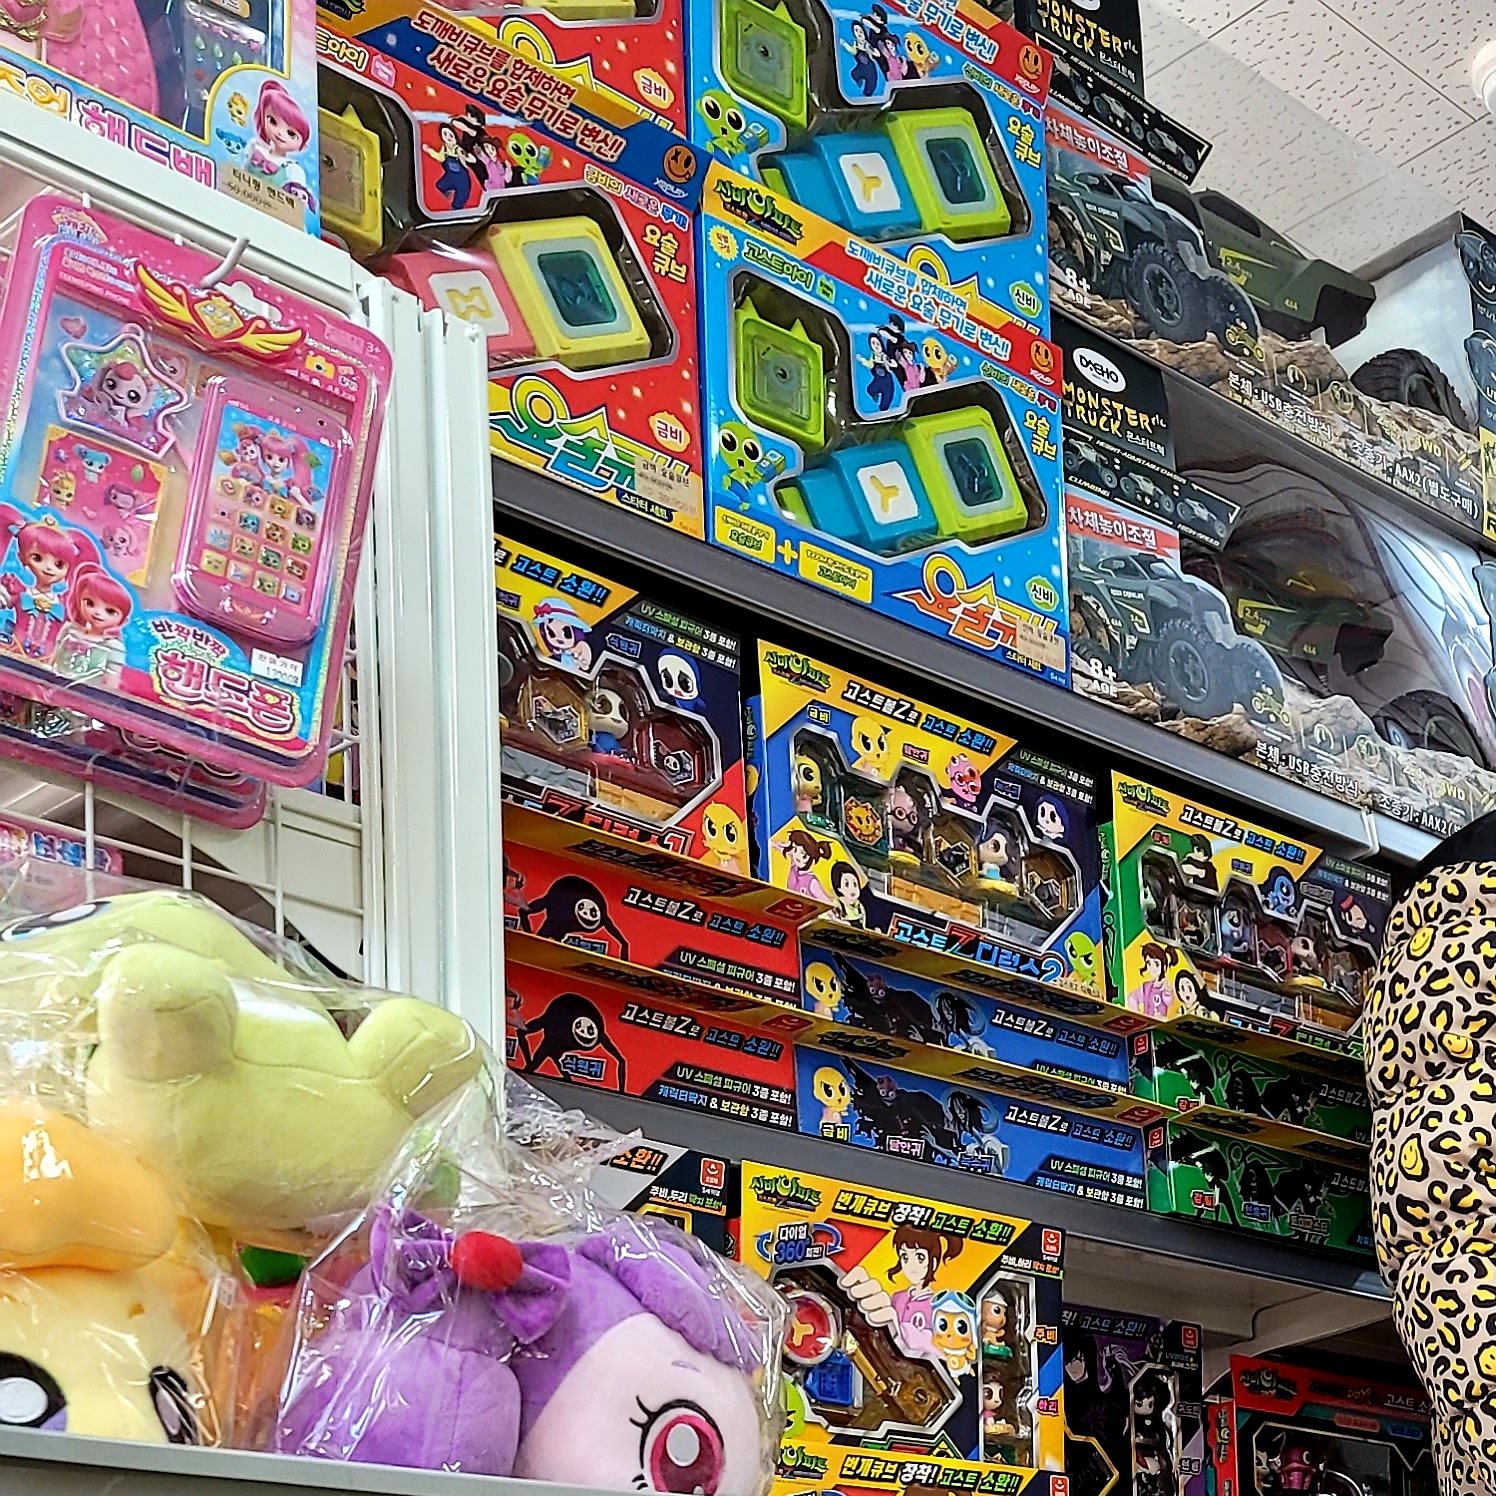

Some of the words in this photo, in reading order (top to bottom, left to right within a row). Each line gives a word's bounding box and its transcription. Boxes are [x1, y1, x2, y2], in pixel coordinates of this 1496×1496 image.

[1041, 9, 1095, 56] TRUCK
[412, 9, 512, 71] 도깨비큐브를
[511, 59, 577, 103] 합체하면
[428, 48, 489, 91] 새로운
[487, 77, 527, 112] 요술
[522, 94, 581, 141] 무기로
[576, 120, 626, 163] 변신!
[638, 78, 669, 102] 금비
[1014, 141, 1042, 170] 큐브
[642, 224, 679, 257] 요술
[652, 252, 688, 283] 큐브
[743, 241, 813, 288] 고스트아이
[865, 270, 908, 303] 새로운
[909, 293, 937, 321] 요술
[936, 307, 978, 343] 무기로
[978, 329, 1011, 359] 변신!
[1014, 288, 1037, 310] 신비
[1063, 380, 1153, 436] MONSTER
[1066, 400, 1123, 438] TRUCK
[656, 419, 683, 445] 금비
[1068, 505, 1158, 548] 차체높이조절
[1031, 583, 1055, 604] 신비
[152, 619, 227, 657] 반짝반짝
[1089, 656, 1117, 681] 8+
[157, 649, 294, 733] 핸드폰
[1092, 679, 1118, 698] AGE
[623, 887, 704, 923] 고스트볼Z로
[708, 914, 744, 935] 고스트
[747, 923, 785, 946] 소환!!
[679, 950, 697, 964] UV
[620, 1003, 701, 1038] 고스트볼Z로
[704, 1029, 740, 1048] 고스트
[677, 1065, 694, 1079] UV
[709, 1098, 719, 1110] &
[778, 1224, 807, 1242] 다이얼
[834, 1191, 891, 1220] 번개큐브
[893, 1202, 930, 1226] 장착!
[933, 1212, 970, 1234] 고스트
[973, 1222, 1013, 1243] 소환!!
[1035, 1327, 1056, 1343] 주비
[1038, 1400, 1058, 1414] 하리
[842, 1456, 898, 1481] 번개큐브
[900, 1462, 937, 1486] 장착!
[940, 1470, 978, 1490] 고스트
[981, 1474, 1020, 1495] 소환!!
